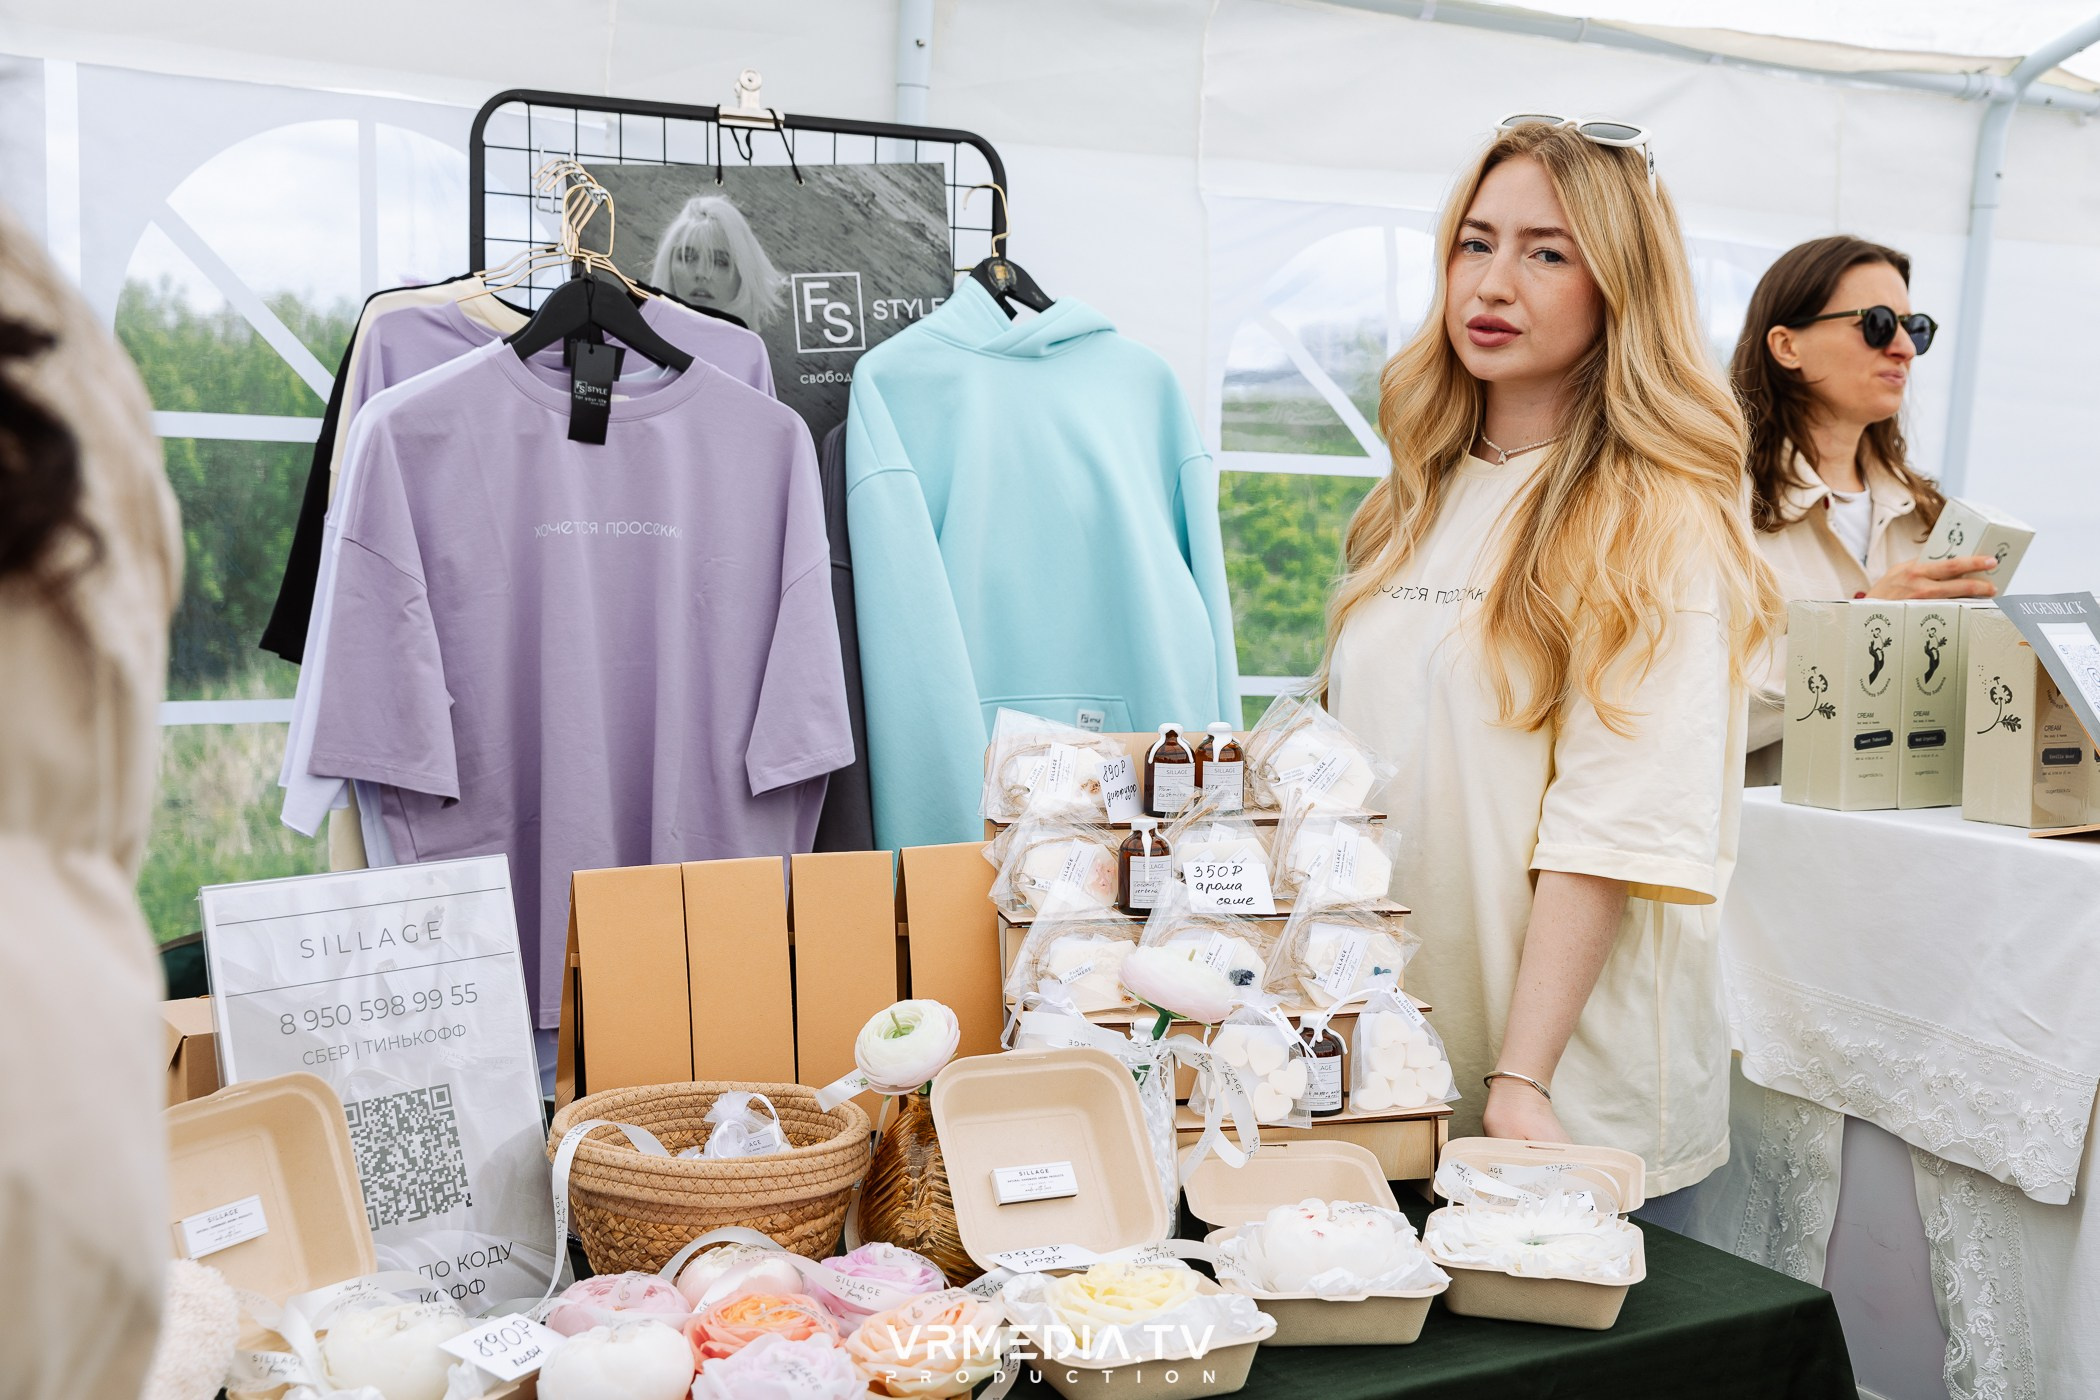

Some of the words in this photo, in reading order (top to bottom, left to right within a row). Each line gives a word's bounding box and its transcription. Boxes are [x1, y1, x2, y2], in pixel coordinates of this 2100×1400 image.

[803, 281, 855, 344] FS
[873, 297, 945, 321] STYLE
[534, 521, 598, 540] хочется
[2018, 600, 2088, 615] AUGENBLICK
[299, 920, 442, 959] SILLAGE
[280, 1013, 297, 1036] 8
[303, 1004, 352, 1032] 950
[360, 995, 406, 1022] 598
[412, 988, 444, 1013] 99
[450, 982, 478, 1007] 55
[302, 1044, 350, 1066] СБЕР
[362, 1023, 467, 1055] ТИНЬКОФФ
[1018, 1168, 1050, 1177] SILLAGE
[207, 1208, 239, 1223] SILLAGE
[418, 1260, 451, 1281] ПО
[456, 1241, 513, 1272] КОДУ
[835, 1275, 881, 1297] SILLAGE
